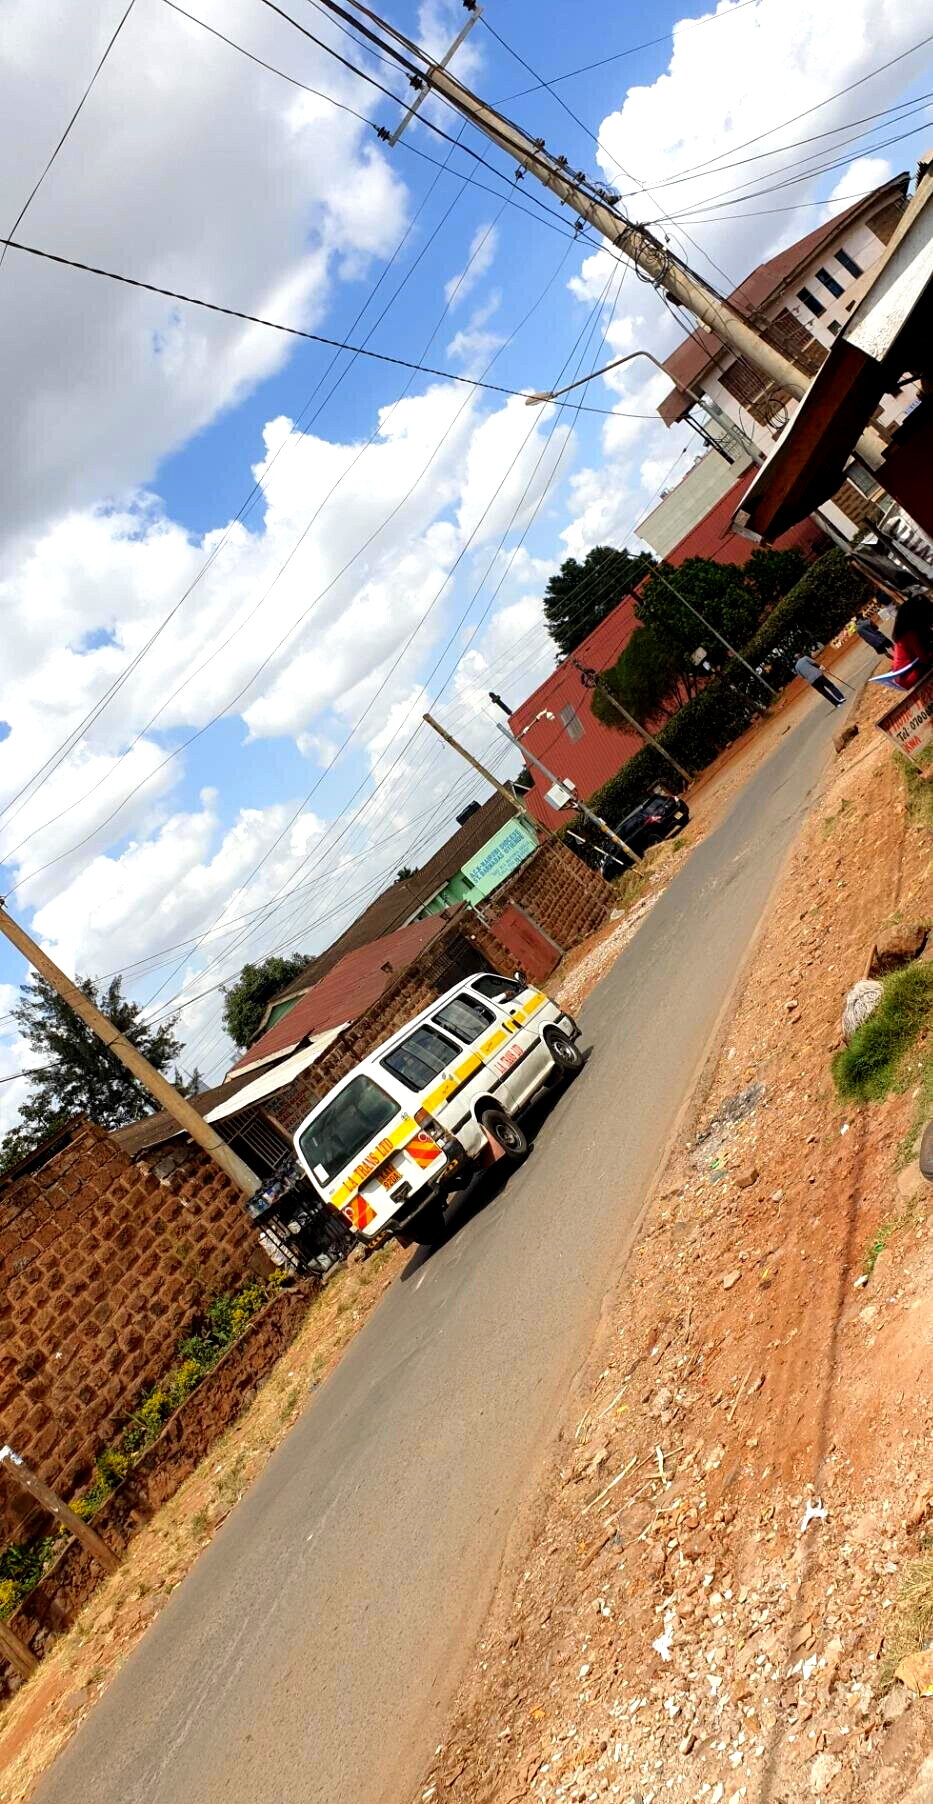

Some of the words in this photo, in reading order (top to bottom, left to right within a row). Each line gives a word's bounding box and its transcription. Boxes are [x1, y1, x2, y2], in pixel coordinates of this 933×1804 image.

[342, 1176, 359, 1192] LA
[353, 1152, 380, 1180] TRANS
[375, 1138, 394, 1157] LTD
